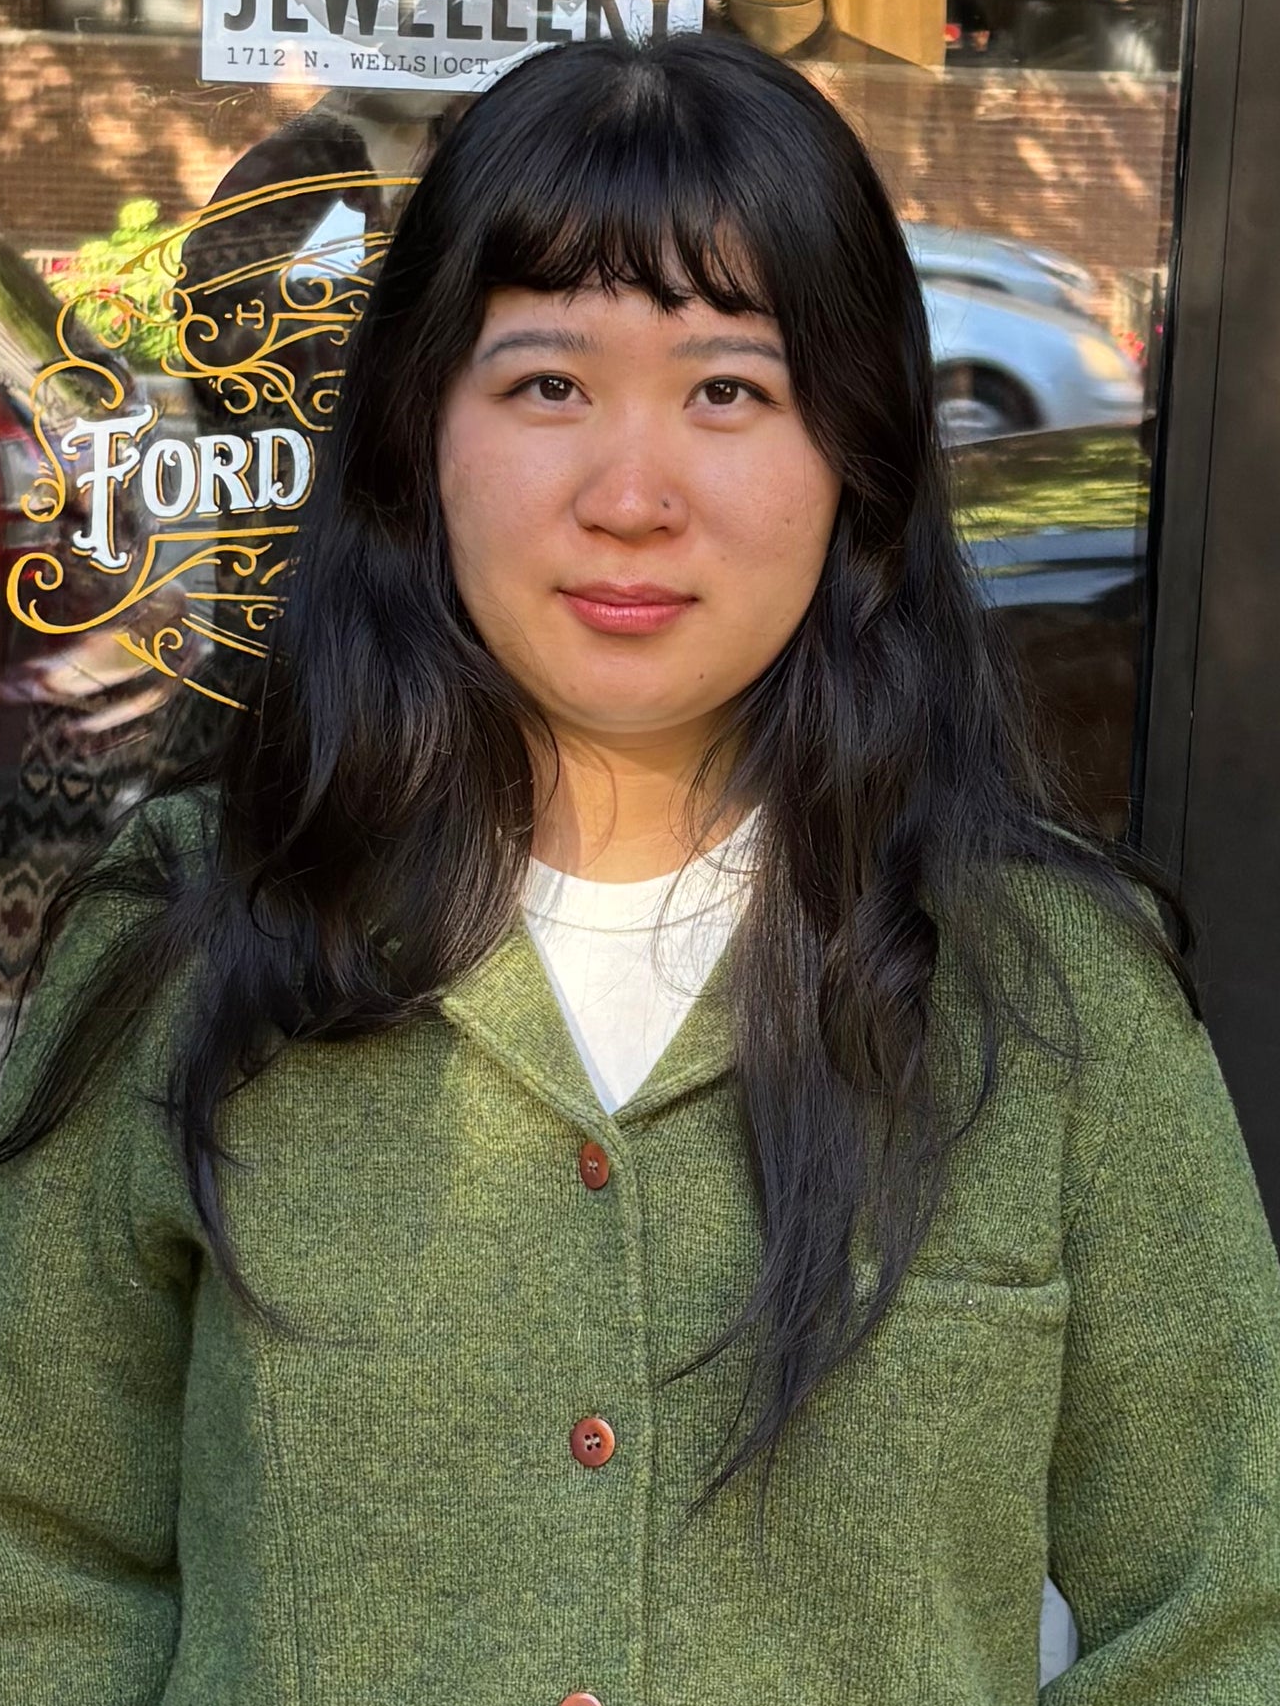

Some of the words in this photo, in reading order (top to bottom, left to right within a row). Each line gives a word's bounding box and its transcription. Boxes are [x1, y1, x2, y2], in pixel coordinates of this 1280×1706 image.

[226, 47, 287, 68] 1712
[304, 50, 331, 70] N.
[61, 404, 315, 571] FORD
